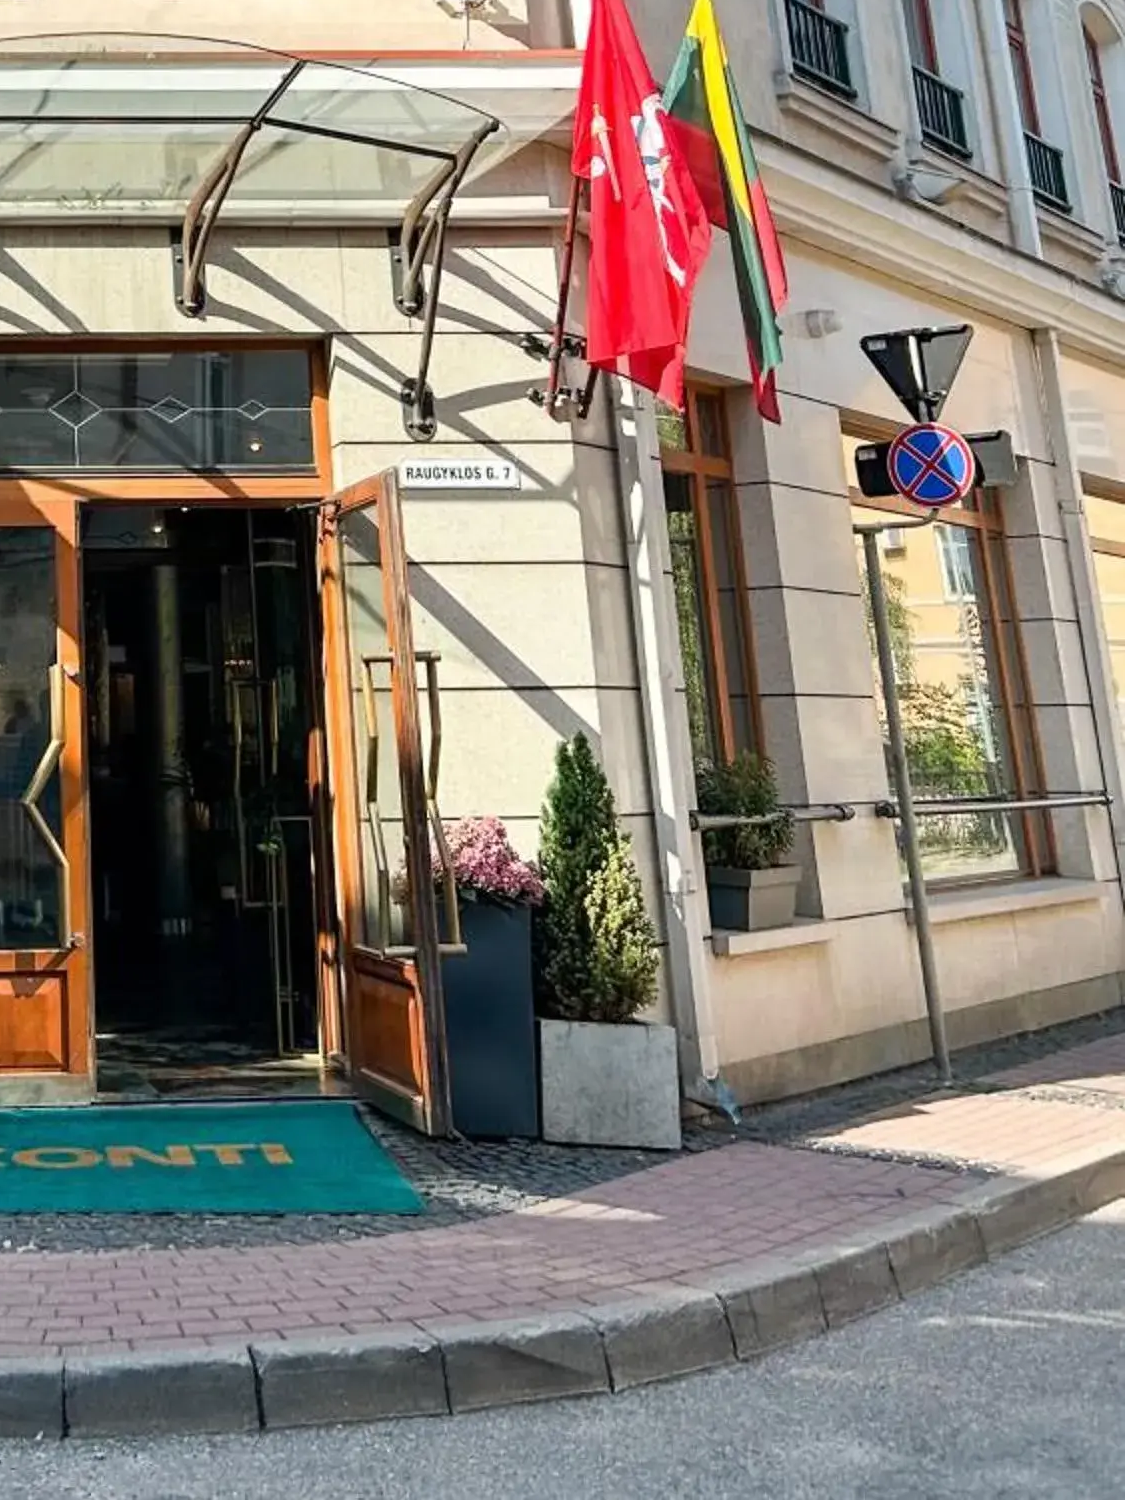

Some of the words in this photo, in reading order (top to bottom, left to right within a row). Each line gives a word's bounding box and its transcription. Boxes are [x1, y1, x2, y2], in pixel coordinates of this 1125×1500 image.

[406, 467, 482, 480] RAUGYKLOS
[486, 468, 499, 480] G.
[503, 468, 511, 479] 7
